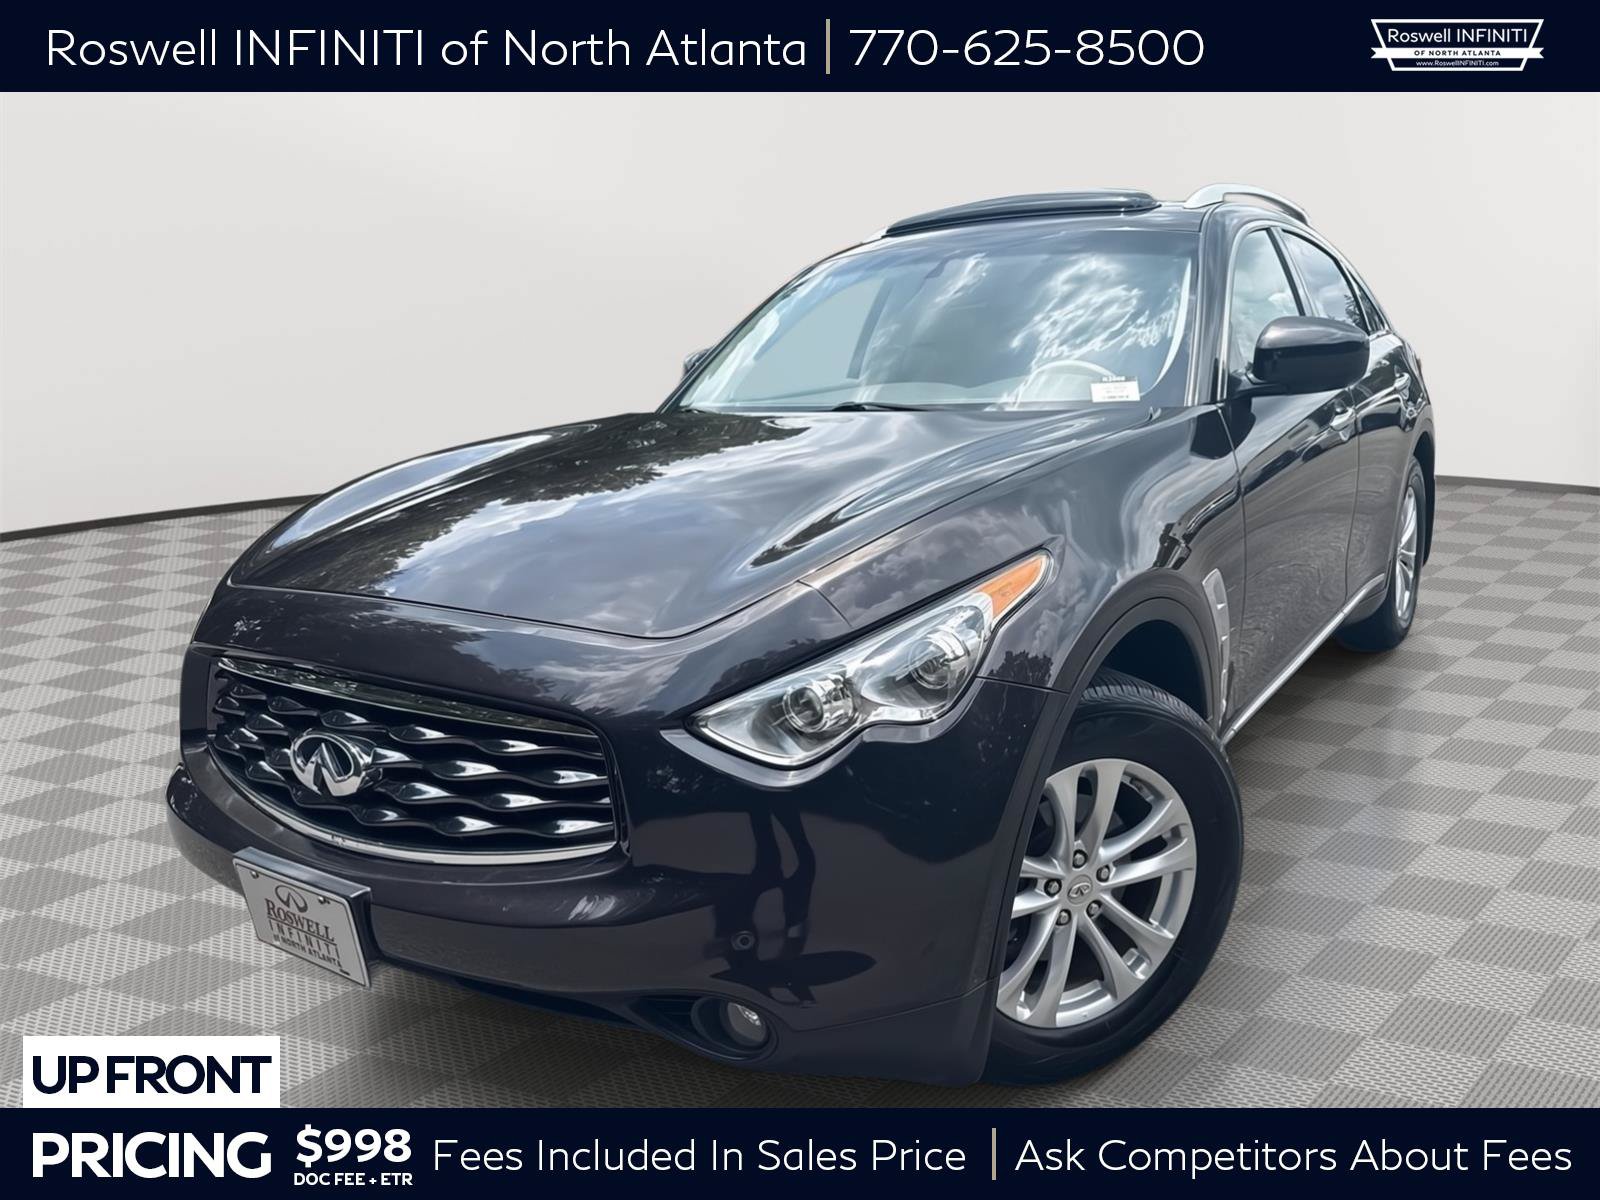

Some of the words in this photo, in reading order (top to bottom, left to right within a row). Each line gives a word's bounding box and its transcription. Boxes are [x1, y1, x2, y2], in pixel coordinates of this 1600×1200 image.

[264, 898, 335, 942] ROSWELL
[268, 919, 340, 959] INFINITI
[280, 936, 307, 953] NORTH
[308, 948, 343, 969] ATLANTA
